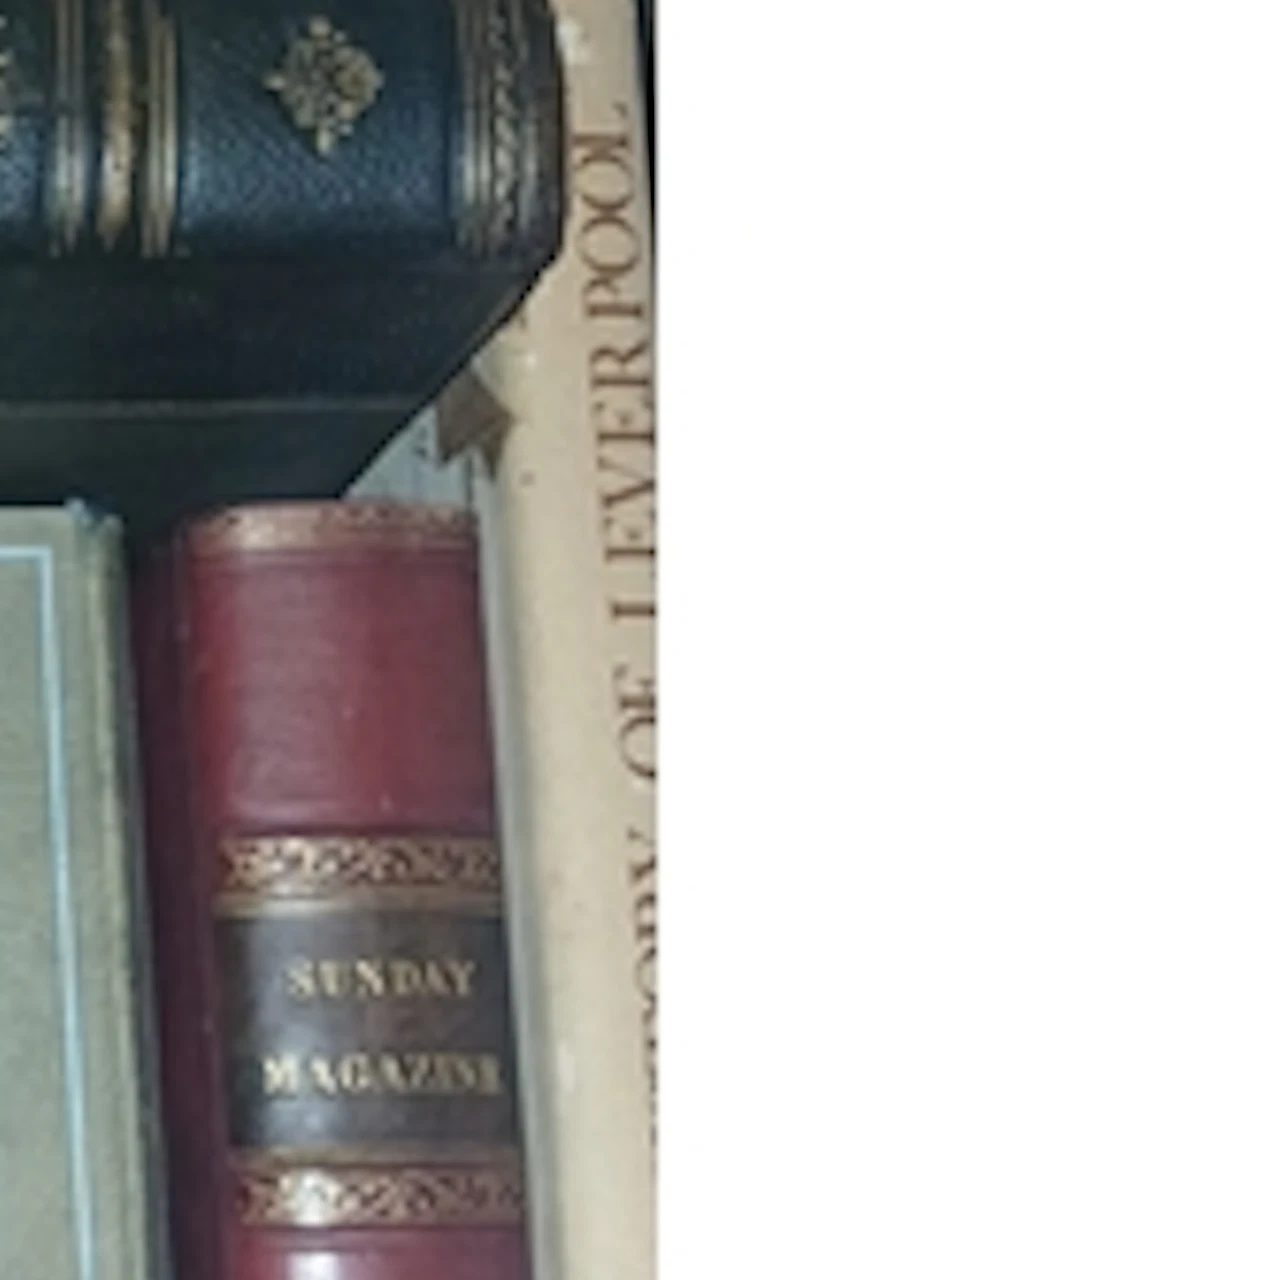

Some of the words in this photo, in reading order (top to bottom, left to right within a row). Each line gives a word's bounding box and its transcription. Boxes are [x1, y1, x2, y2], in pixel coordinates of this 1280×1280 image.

[572, 100, 656, 622] LEVERPOOL
[286, 954, 477, 999] SUNDAY
[261, 1051, 502, 1096] MAGAZINE
